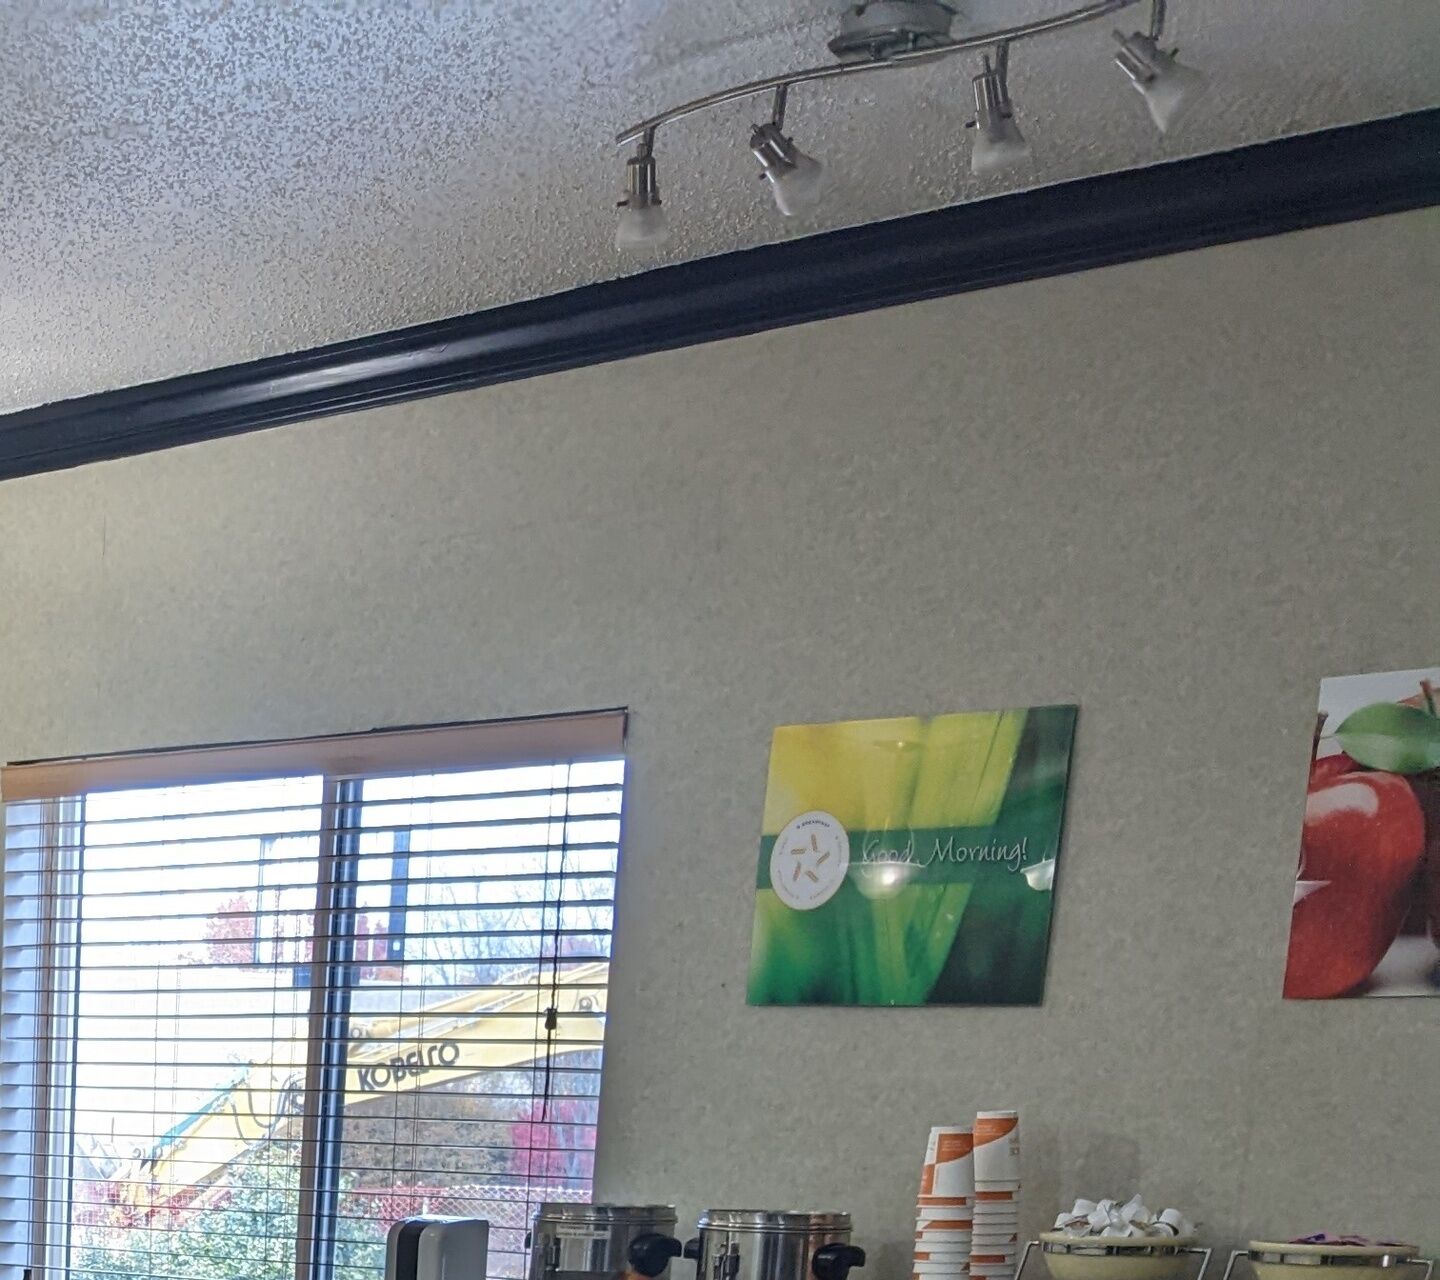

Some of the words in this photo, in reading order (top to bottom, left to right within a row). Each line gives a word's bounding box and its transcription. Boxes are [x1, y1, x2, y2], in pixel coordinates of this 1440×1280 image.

[862, 838, 914, 877] Good
[917, 835, 1029, 872] Morning!
[357, 1041, 459, 1091] KOBELCO
